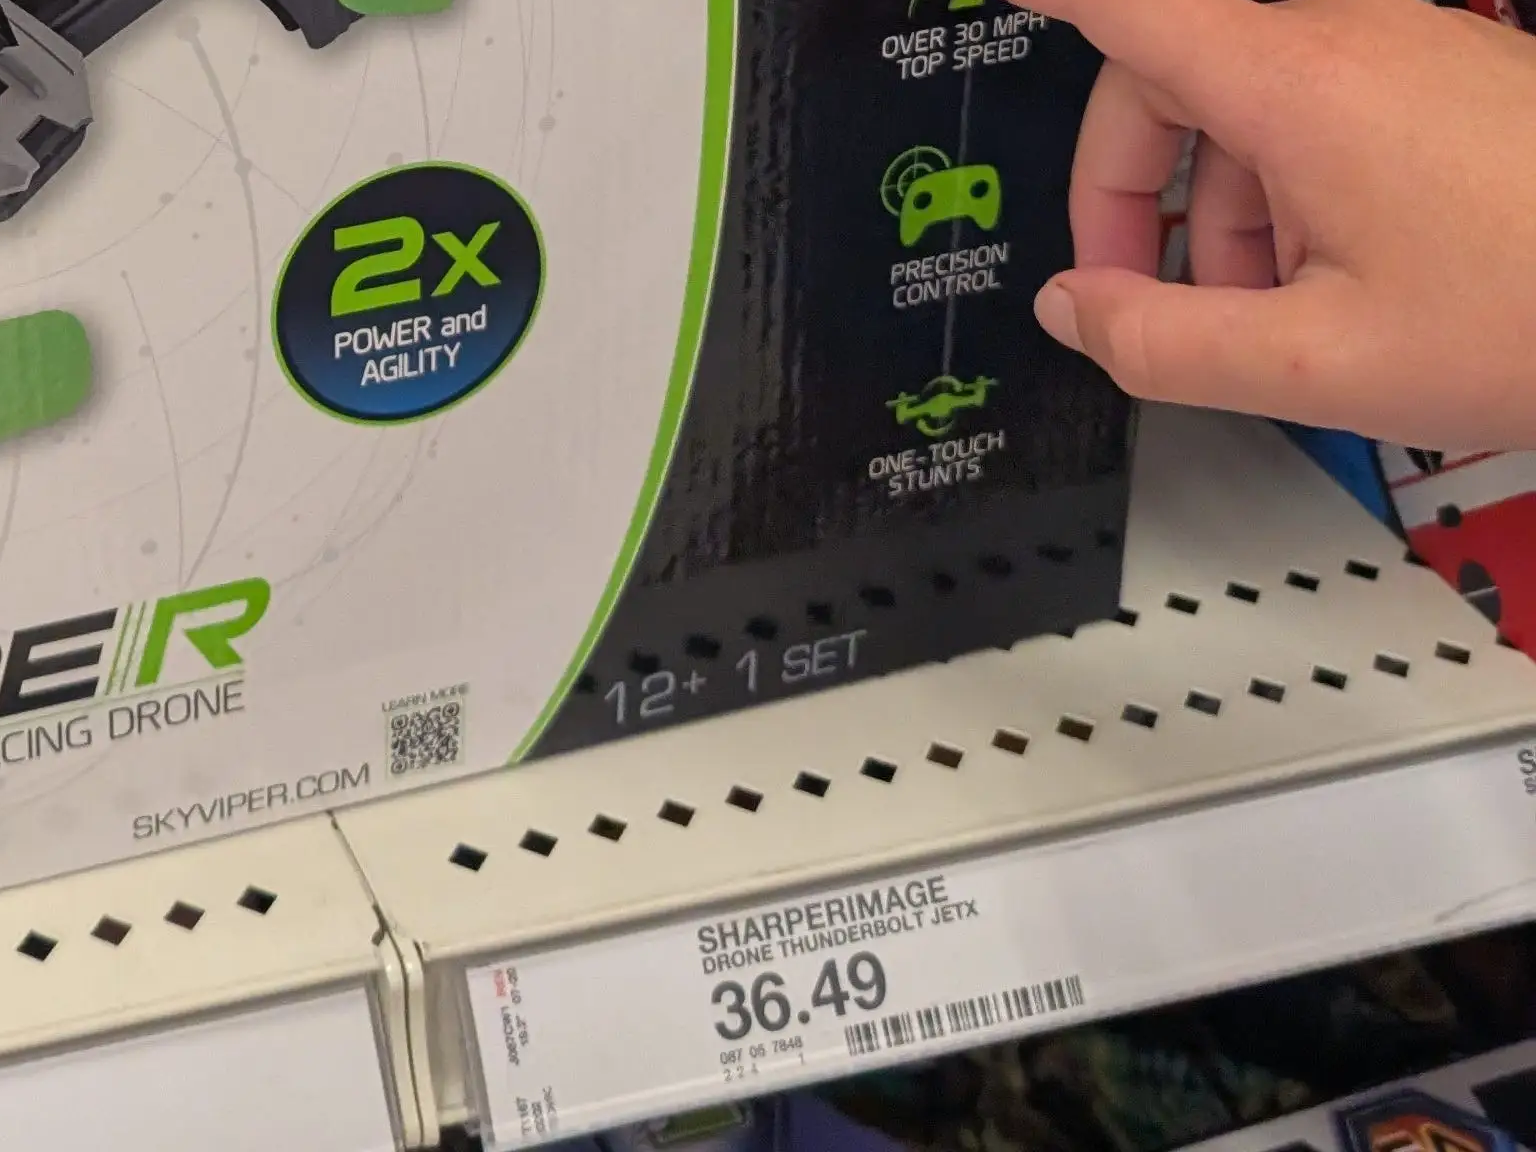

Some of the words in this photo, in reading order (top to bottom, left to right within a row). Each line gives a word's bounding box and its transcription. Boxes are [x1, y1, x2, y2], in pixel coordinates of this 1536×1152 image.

[882, 26, 947, 59] OVER
[954, 20, 984, 46] 30
[993, 10, 1049, 38] MPH
[896, 53, 947, 80] TOP
[952, 36, 1032, 71] SPEED
[891, 242, 1010, 285] PRECISION
[893, 269, 1004, 309] CONTROL
[333, 316, 431, 359] POWER
[440, 304, 487, 337] and
[359, 342, 462, 387] AGILITY
[868, 429, 1006, 481] ONE-TOUCH
[887, 458, 982, 498] STUNTS
[381, 691, 428, 714] LEARN
[430, 681, 470, 703] MORE
[604, 671, 706, 726] 12+
[735, 650, 759, 693] 1
[781, 630, 868, 683] SET
[108, 679, 246, 741] DRONE
[132, 762, 371, 840] SKYVIPER.COM
[697, 875, 948, 956] SHARPERIMAGE
[702, 943, 774, 976] DRONE
[778, 913, 925, 960] THUNDERBOLT
[930, 898, 980, 928] JETX
[711, 950, 887, 1042] 36.49
